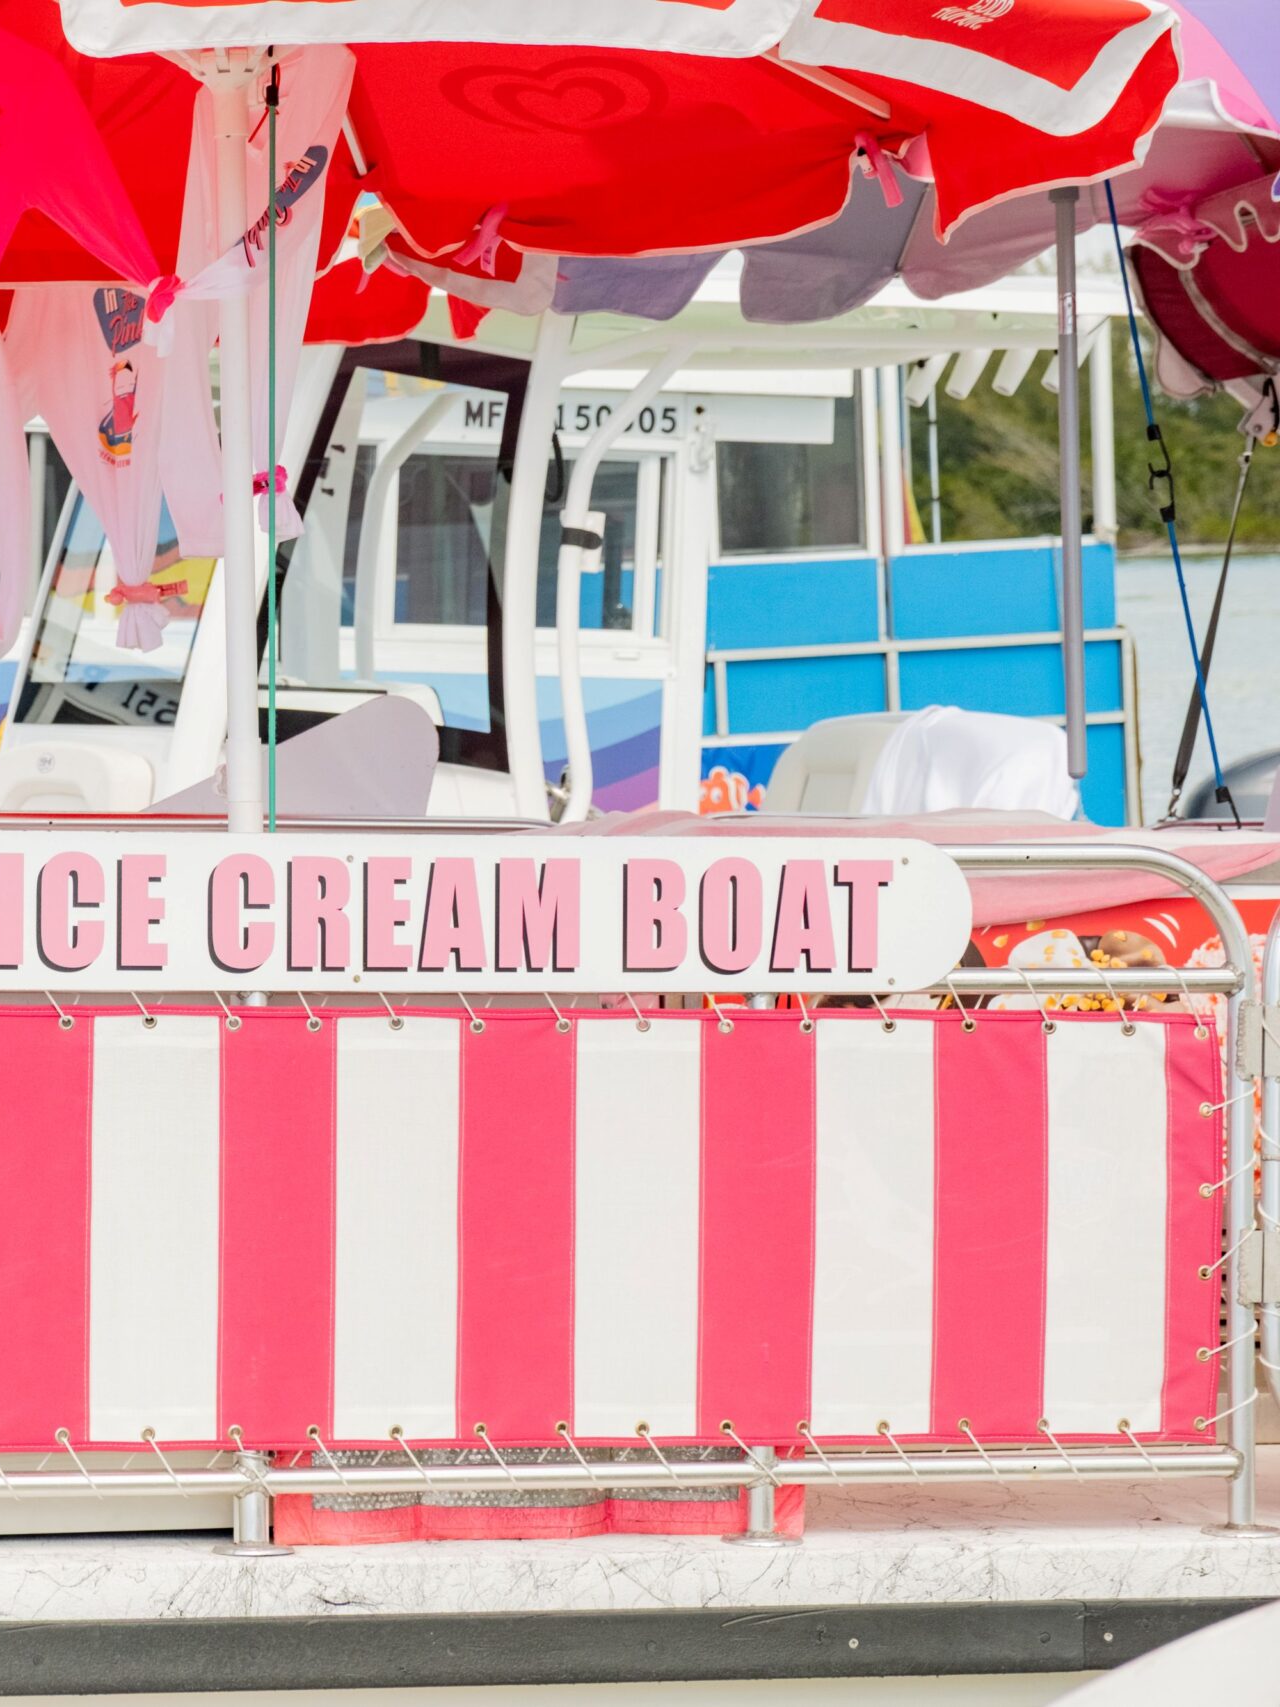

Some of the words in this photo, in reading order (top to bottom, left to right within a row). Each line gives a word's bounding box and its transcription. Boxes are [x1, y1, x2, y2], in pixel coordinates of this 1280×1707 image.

[556, 404, 677, 434] 15005
[206, 852, 582, 974] CREAM
[622, 856, 894, 975] BOAT
